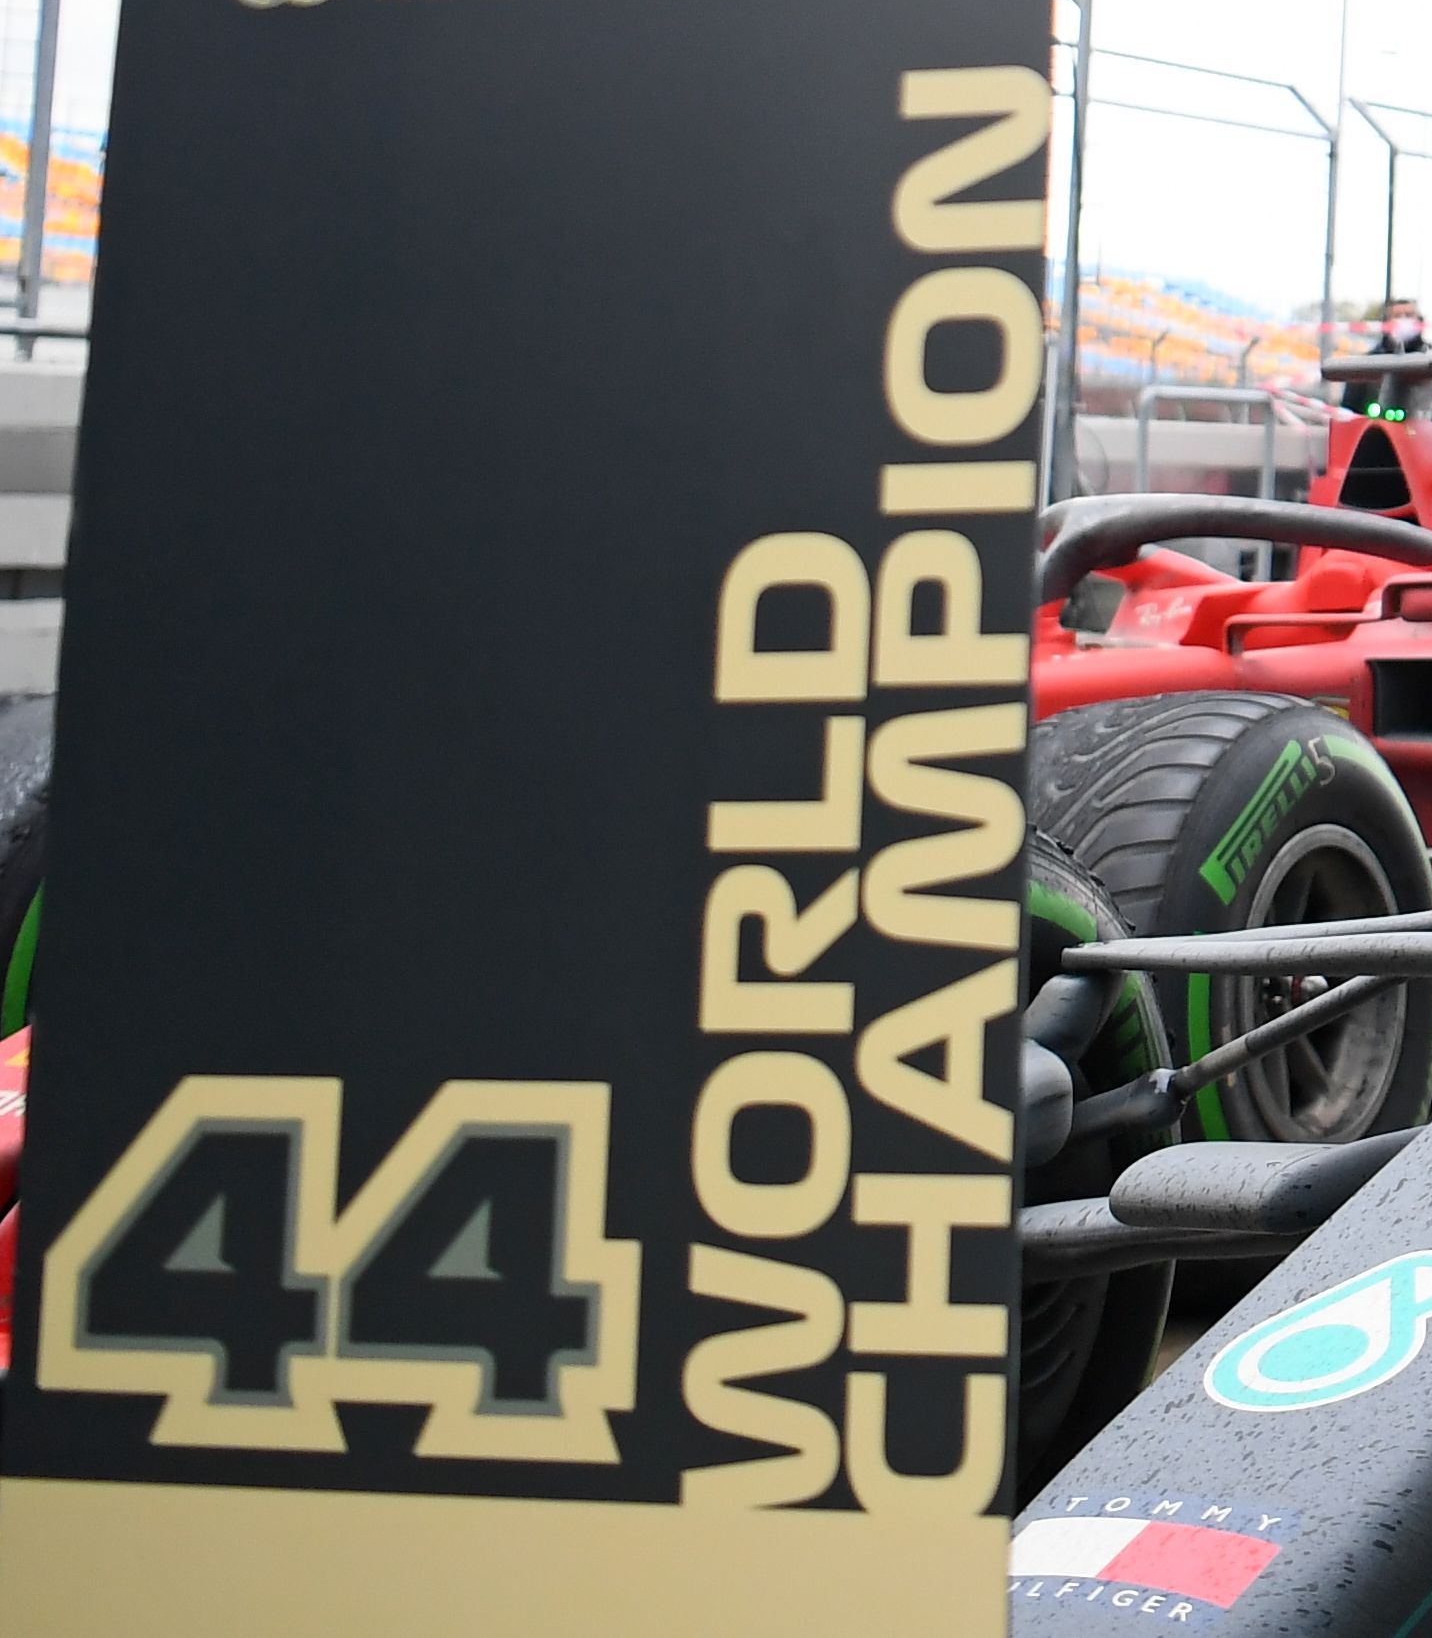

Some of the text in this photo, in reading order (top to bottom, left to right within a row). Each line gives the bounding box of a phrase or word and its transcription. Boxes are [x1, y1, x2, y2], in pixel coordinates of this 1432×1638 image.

[845, 63, 1053, 1516] CHAMPION
[1198, 739, 1318, 906] PIRELLI
[680, 530, 872, 1509] WORLD
[36, 1074, 645, 1465] 44
[1006, 1581, 1194, 1623] ILFIGER
[1065, 1496, 1282, 1532] TOMMY
